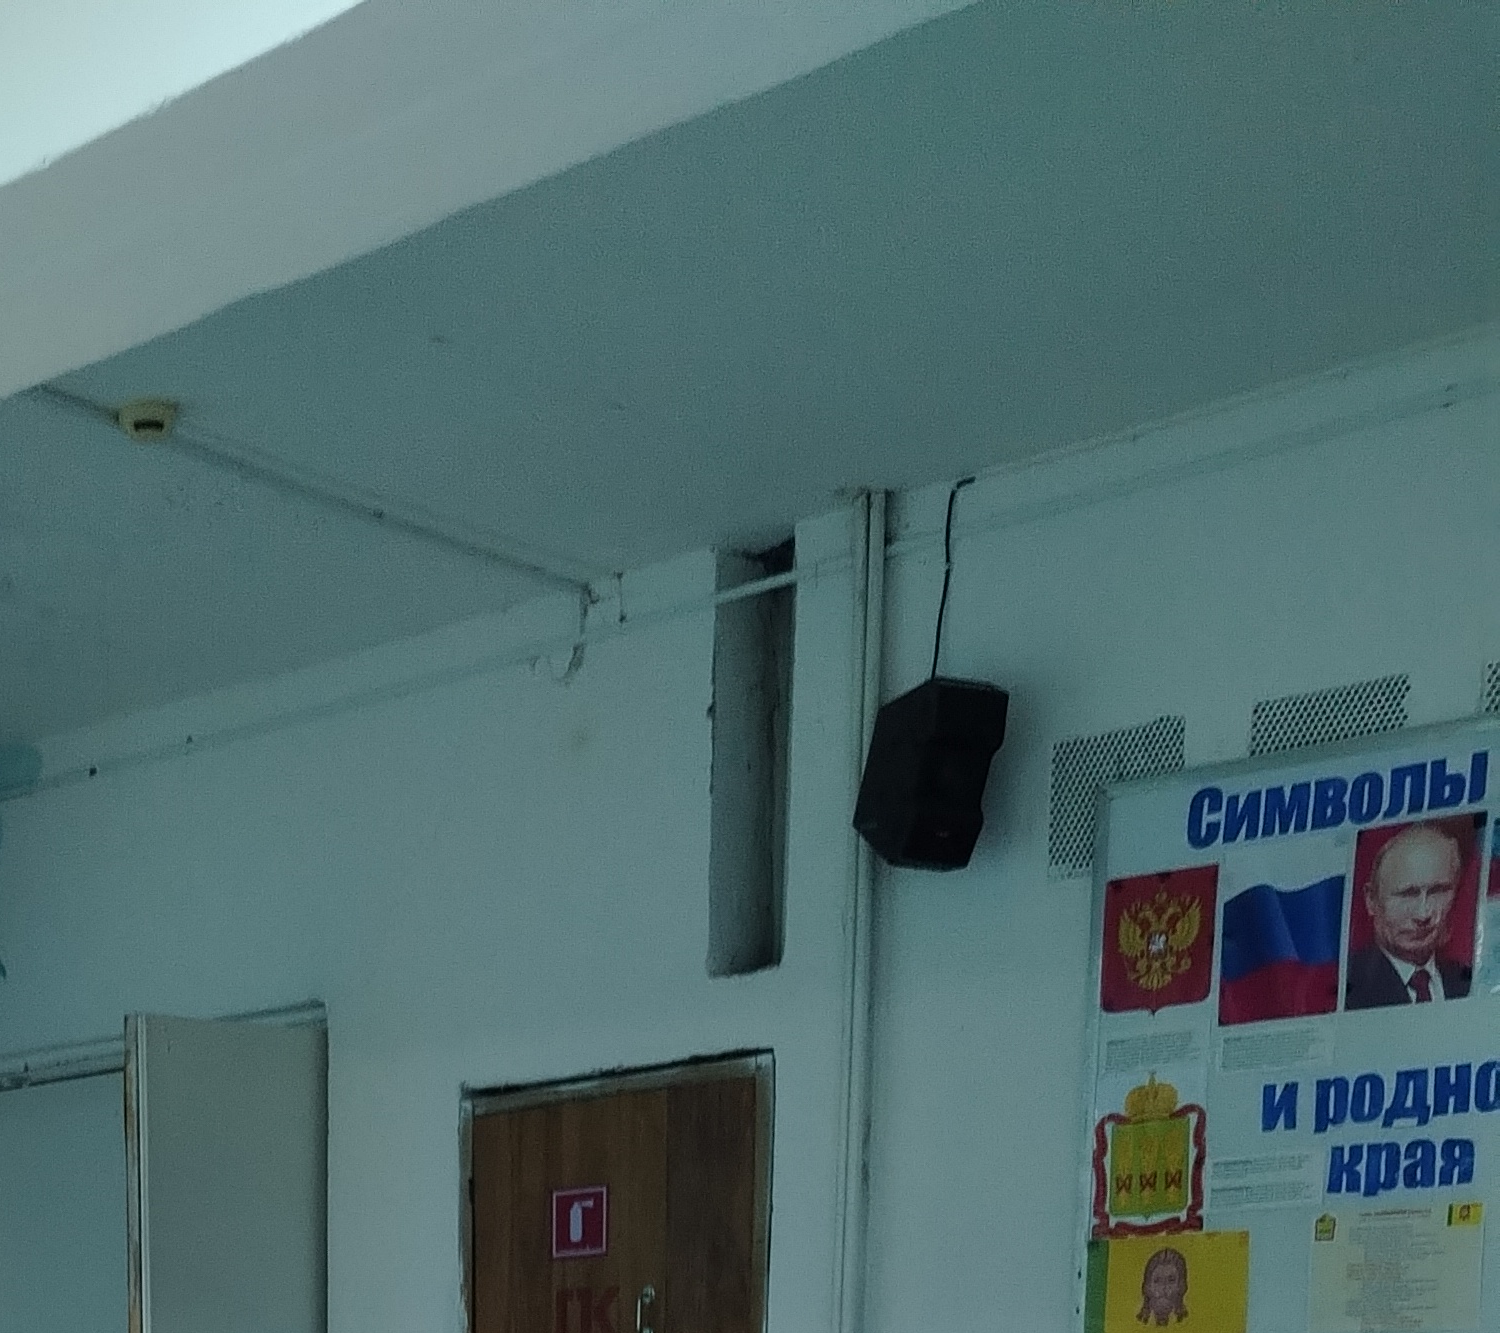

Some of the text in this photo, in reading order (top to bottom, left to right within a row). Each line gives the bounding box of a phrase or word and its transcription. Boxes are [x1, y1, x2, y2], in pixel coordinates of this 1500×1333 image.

[1186, 750, 1489, 850] Символы
[1261, 1081, 1299, 1133] и
[1326, 1137, 1476, 1197] края
